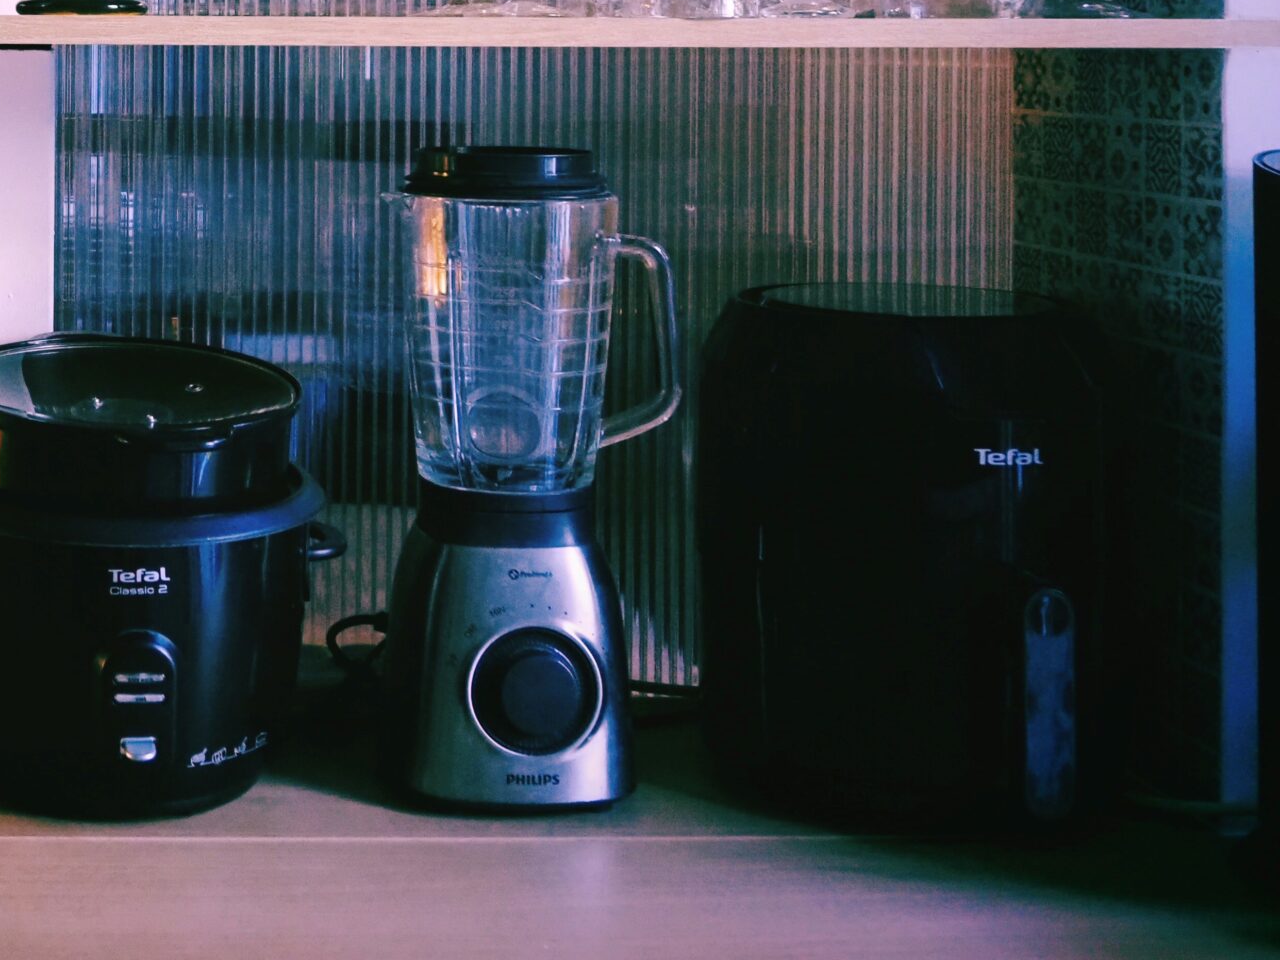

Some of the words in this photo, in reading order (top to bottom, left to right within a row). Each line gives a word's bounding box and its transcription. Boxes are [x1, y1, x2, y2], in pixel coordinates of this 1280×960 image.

[973, 447, 1044, 465] Tefal
[108, 567, 170, 583] Tefal
[110, 586, 154, 595] Classic
[158, 584, 168, 594] 2
[506, 774, 560, 785] PHILIPS
